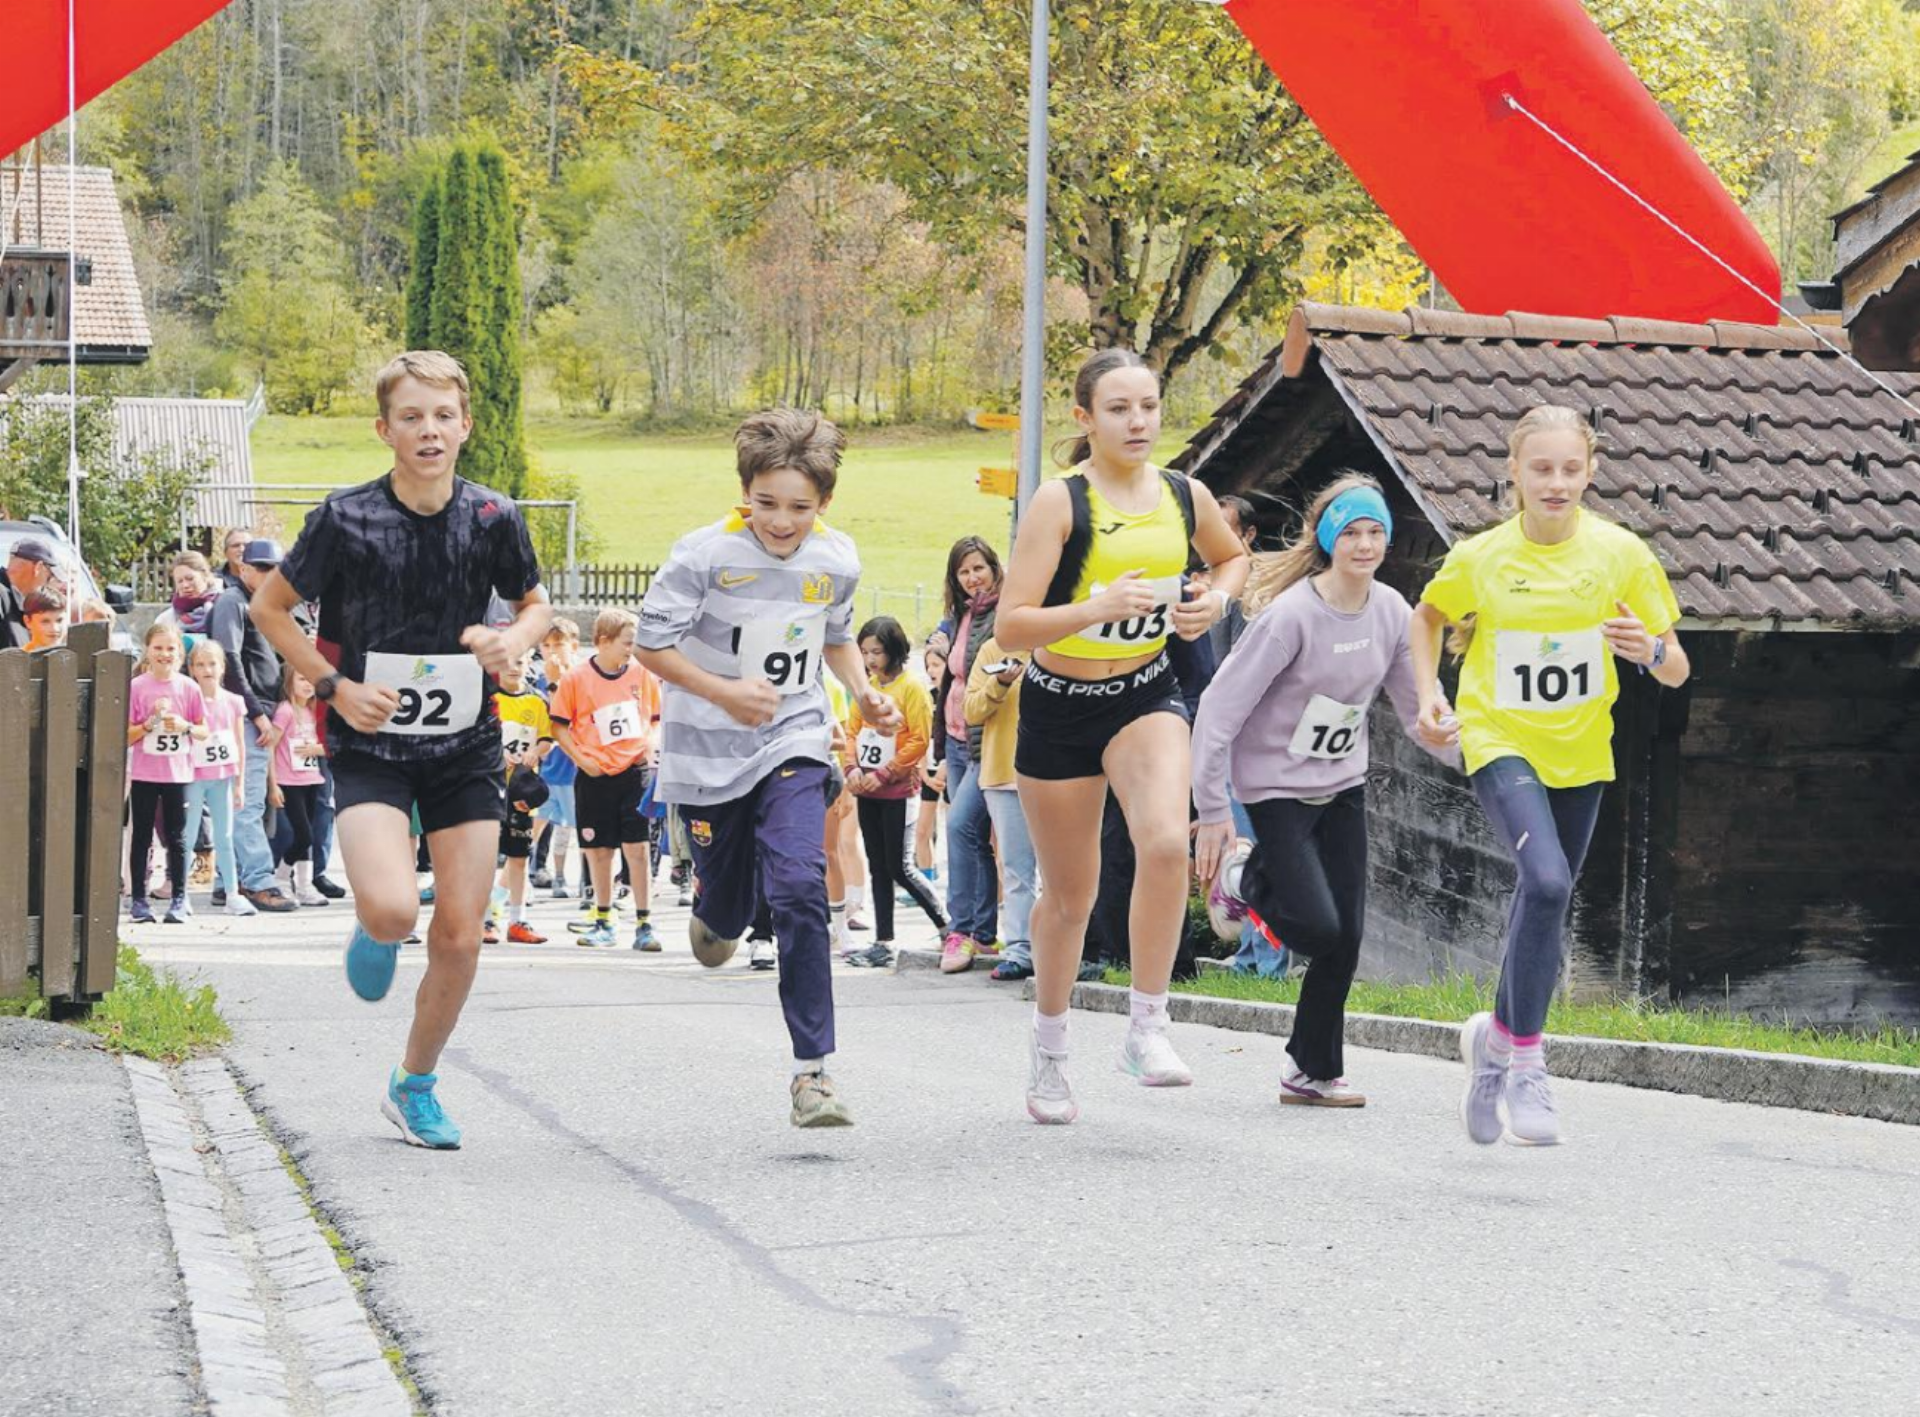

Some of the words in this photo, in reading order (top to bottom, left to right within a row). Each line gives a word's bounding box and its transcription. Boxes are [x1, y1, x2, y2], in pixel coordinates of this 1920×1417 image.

[763, 649, 809, 687] 91
[1027, 658, 1068, 693] NIKE
[1067, 681, 1126, 697] PRO
[1513, 662, 1589, 703] 101
[390, 687, 453, 726] 92
[609, 718, 631, 737] 61
[156, 734, 180, 752] 53
[206, 746, 230, 763] 58
[860, 744, 882, 765] 78
